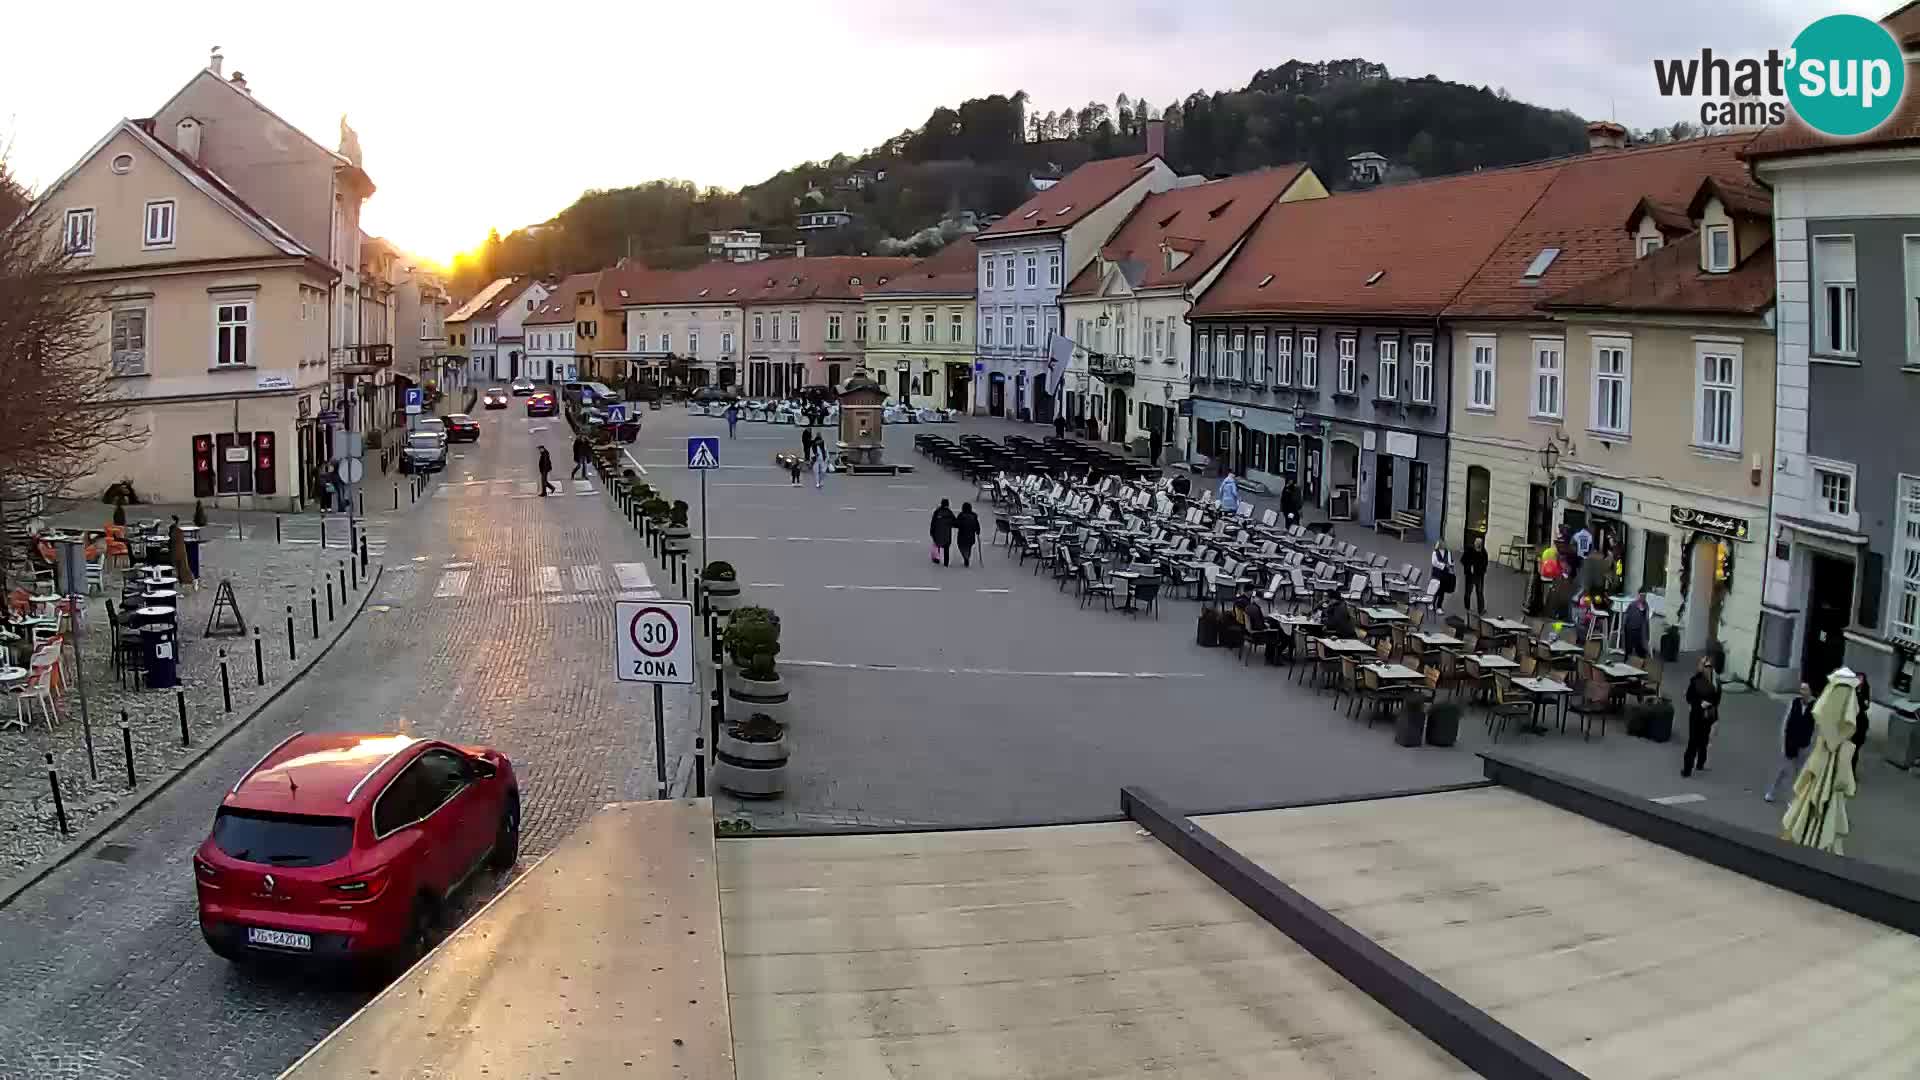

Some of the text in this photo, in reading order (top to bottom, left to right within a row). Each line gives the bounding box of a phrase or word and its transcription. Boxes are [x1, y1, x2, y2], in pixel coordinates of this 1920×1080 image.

[409, 392, 417, 403] P
[643, 623, 667, 644] 30
[633, 661, 678, 677] ZONA
